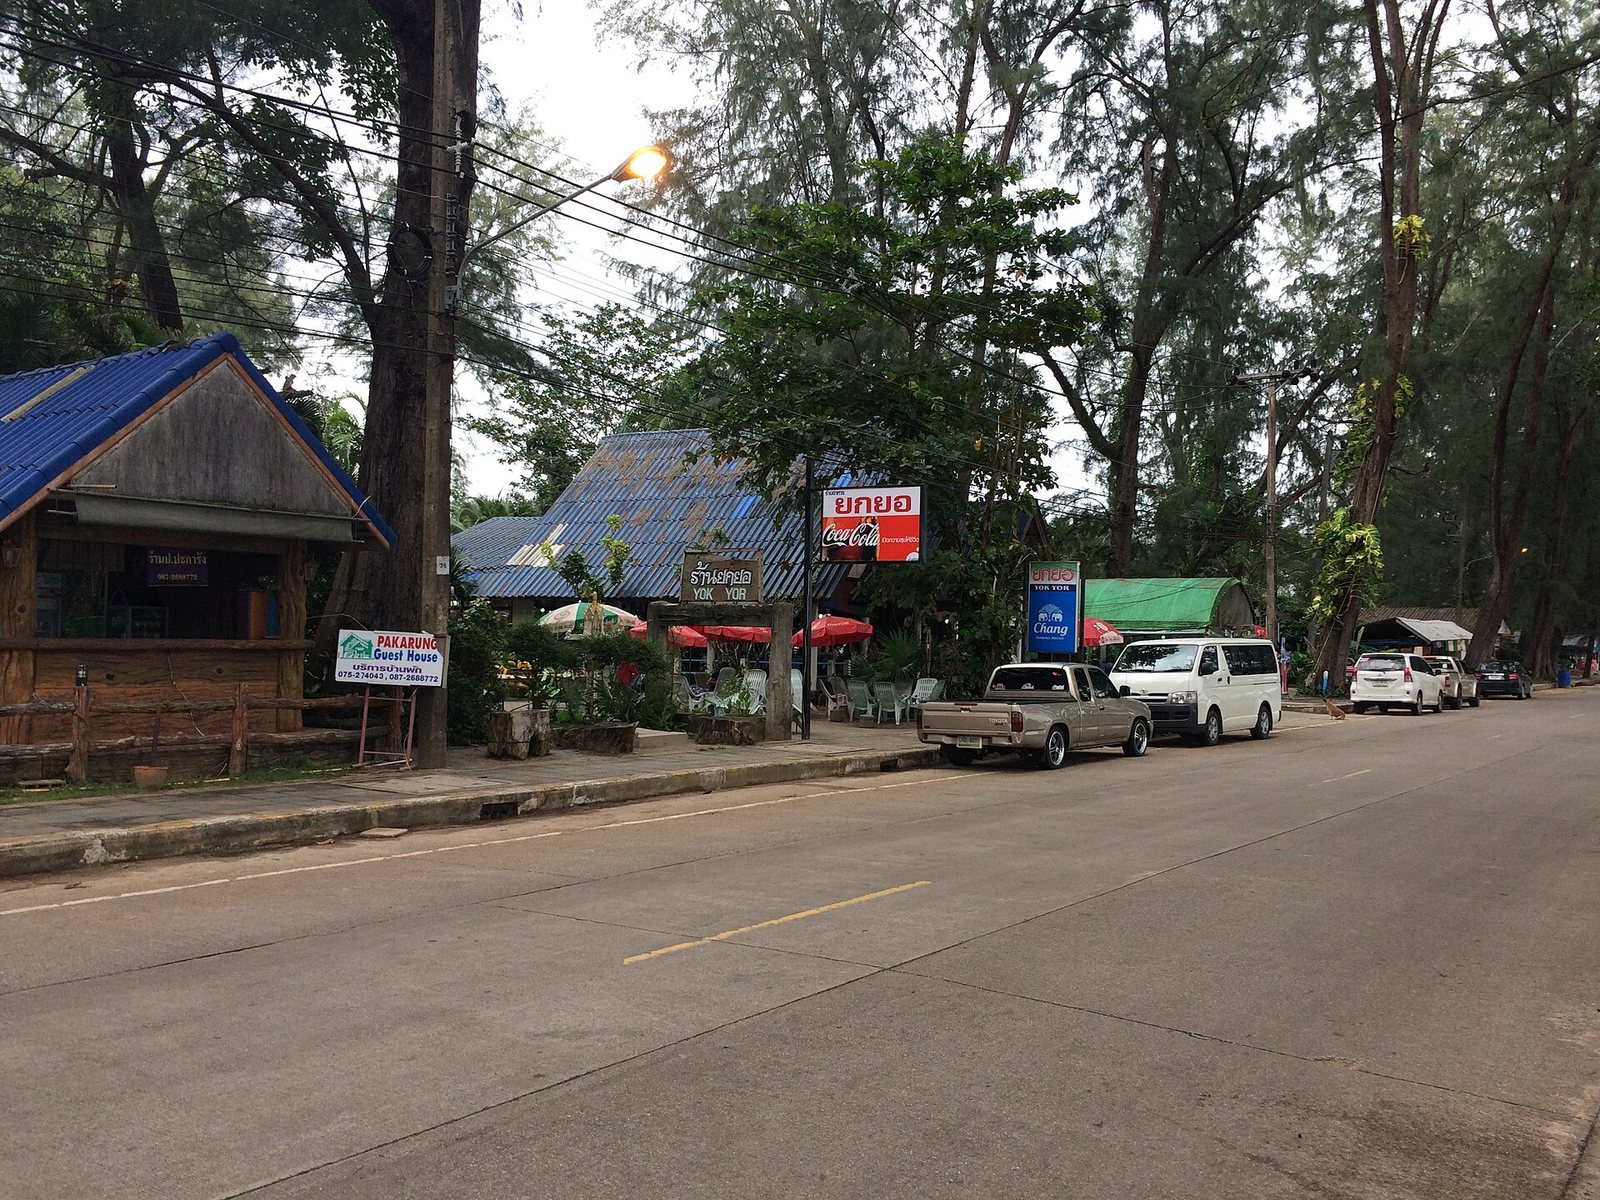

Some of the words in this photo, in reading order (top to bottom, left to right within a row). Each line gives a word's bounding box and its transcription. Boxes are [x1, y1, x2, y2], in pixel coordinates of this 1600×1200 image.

[835, 495, 912, 515] ยกยอ
[822, 522, 880, 547] Coca-Cola
[690, 560, 752, 586] ร้านยกยอ
[1032, 567, 1075, 582] ยกยอ
[693, 587, 714, 600] YOK
[725, 587, 747, 600] YOR
[1033, 621, 1069, 637] Chang
[377, 635, 438, 650] PAKARUNG
[373, 648, 404, 661] Guest
[407, 650, 438, 663] House
[389, 673, 439, 682] 087-2688772
